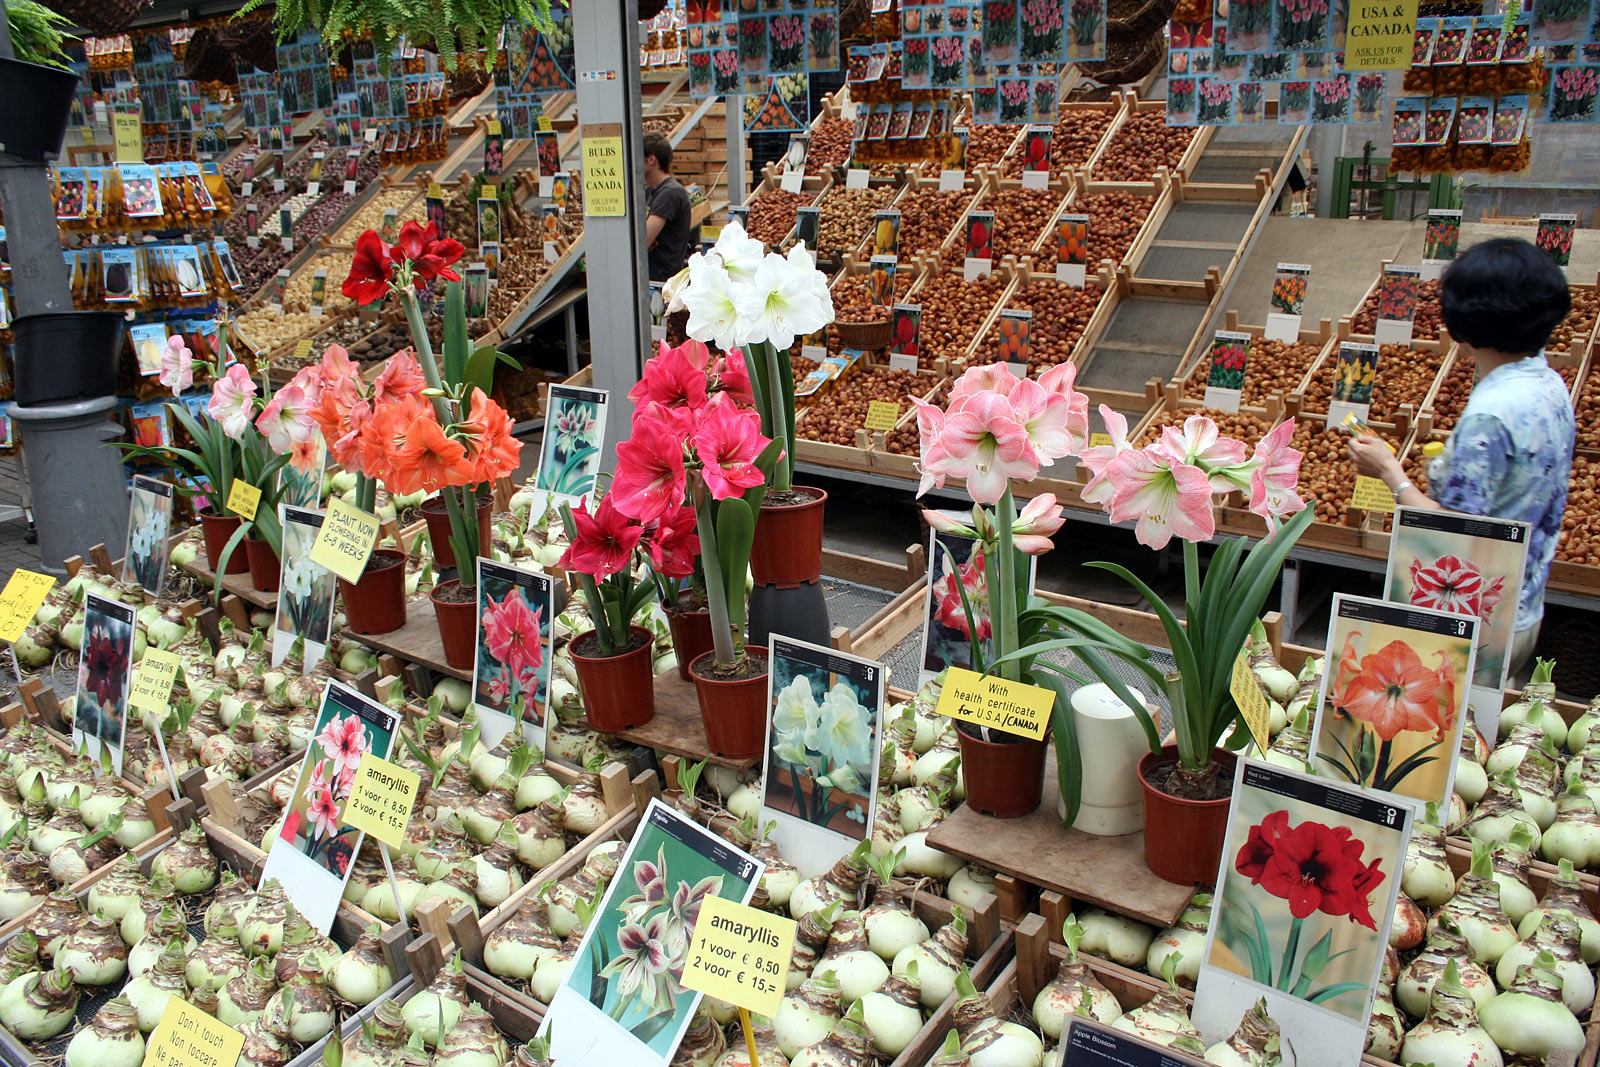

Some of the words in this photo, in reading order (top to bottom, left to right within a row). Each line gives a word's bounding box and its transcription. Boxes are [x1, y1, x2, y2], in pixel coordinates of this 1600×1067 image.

[1362, 6, 1388, 19] USA
[1392, 4, 1404, 16] &
[1351, 23, 1411, 37] CANADA
[1355, 48, 1371, 56] ASK
[1374, 46, 1384, 56] US
[1386, 46, 1403, 54] FOR
[1360, 57, 1396, 66] DETAILS
[588, 147, 616, 157] BULBS
[590, 168, 606, 177] USA
[608, 168, 616, 176] &
[586, 181, 622, 190] CANADA
[332, 509, 358, 528] PLANT
[358, 520, 375, 538] NOW
[328, 522, 361, 544] FLOWERING
[362, 539, 369, 549] IN
[324, 532, 338, 546] 6-8
[338, 540, 365, 560] WEEKS
[17, 586, 29, 599] 2
[146, 658, 174, 674] amaryllis
[988, 682, 1009, 697] With
[954, 688, 982, 704] health
[987, 699, 1036, 718] certificate
[958, 704, 974, 716] for
[366, 768, 410, 794] amaryllis
[352, 798, 359, 808] 2
[360, 803, 376, 816] voor
[379, 811, 385, 821] €
[358, 785, 363, 794] 1
[364, 789, 381, 802] voor
[384, 798, 389, 807] €
[391, 801, 407, 815] 8,50
[711, 915, 780, 948] amaryllis
[700, 938, 706, 949] 1
[710, 943, 736, 960] voor
[742, 954, 750, 964] €
[755, 957, 780, 975] 8,50
[693, 956, 702, 968] 2
[704, 962, 731, 978] voor
[737, 972, 746, 983] €
[752, 976, 776, 993] 15,=
[178, 1011, 200, 1034] Don't
[201, 1028, 224, 1049] touch
[1074, 1029, 1091, 1040] Apple
[1092, 1035, 1117, 1049] Blossom
[155, 1044, 166, 1062] Ne
[169, 1030, 185, 1049] Non
[187, 1043, 218, 1067] toccare
